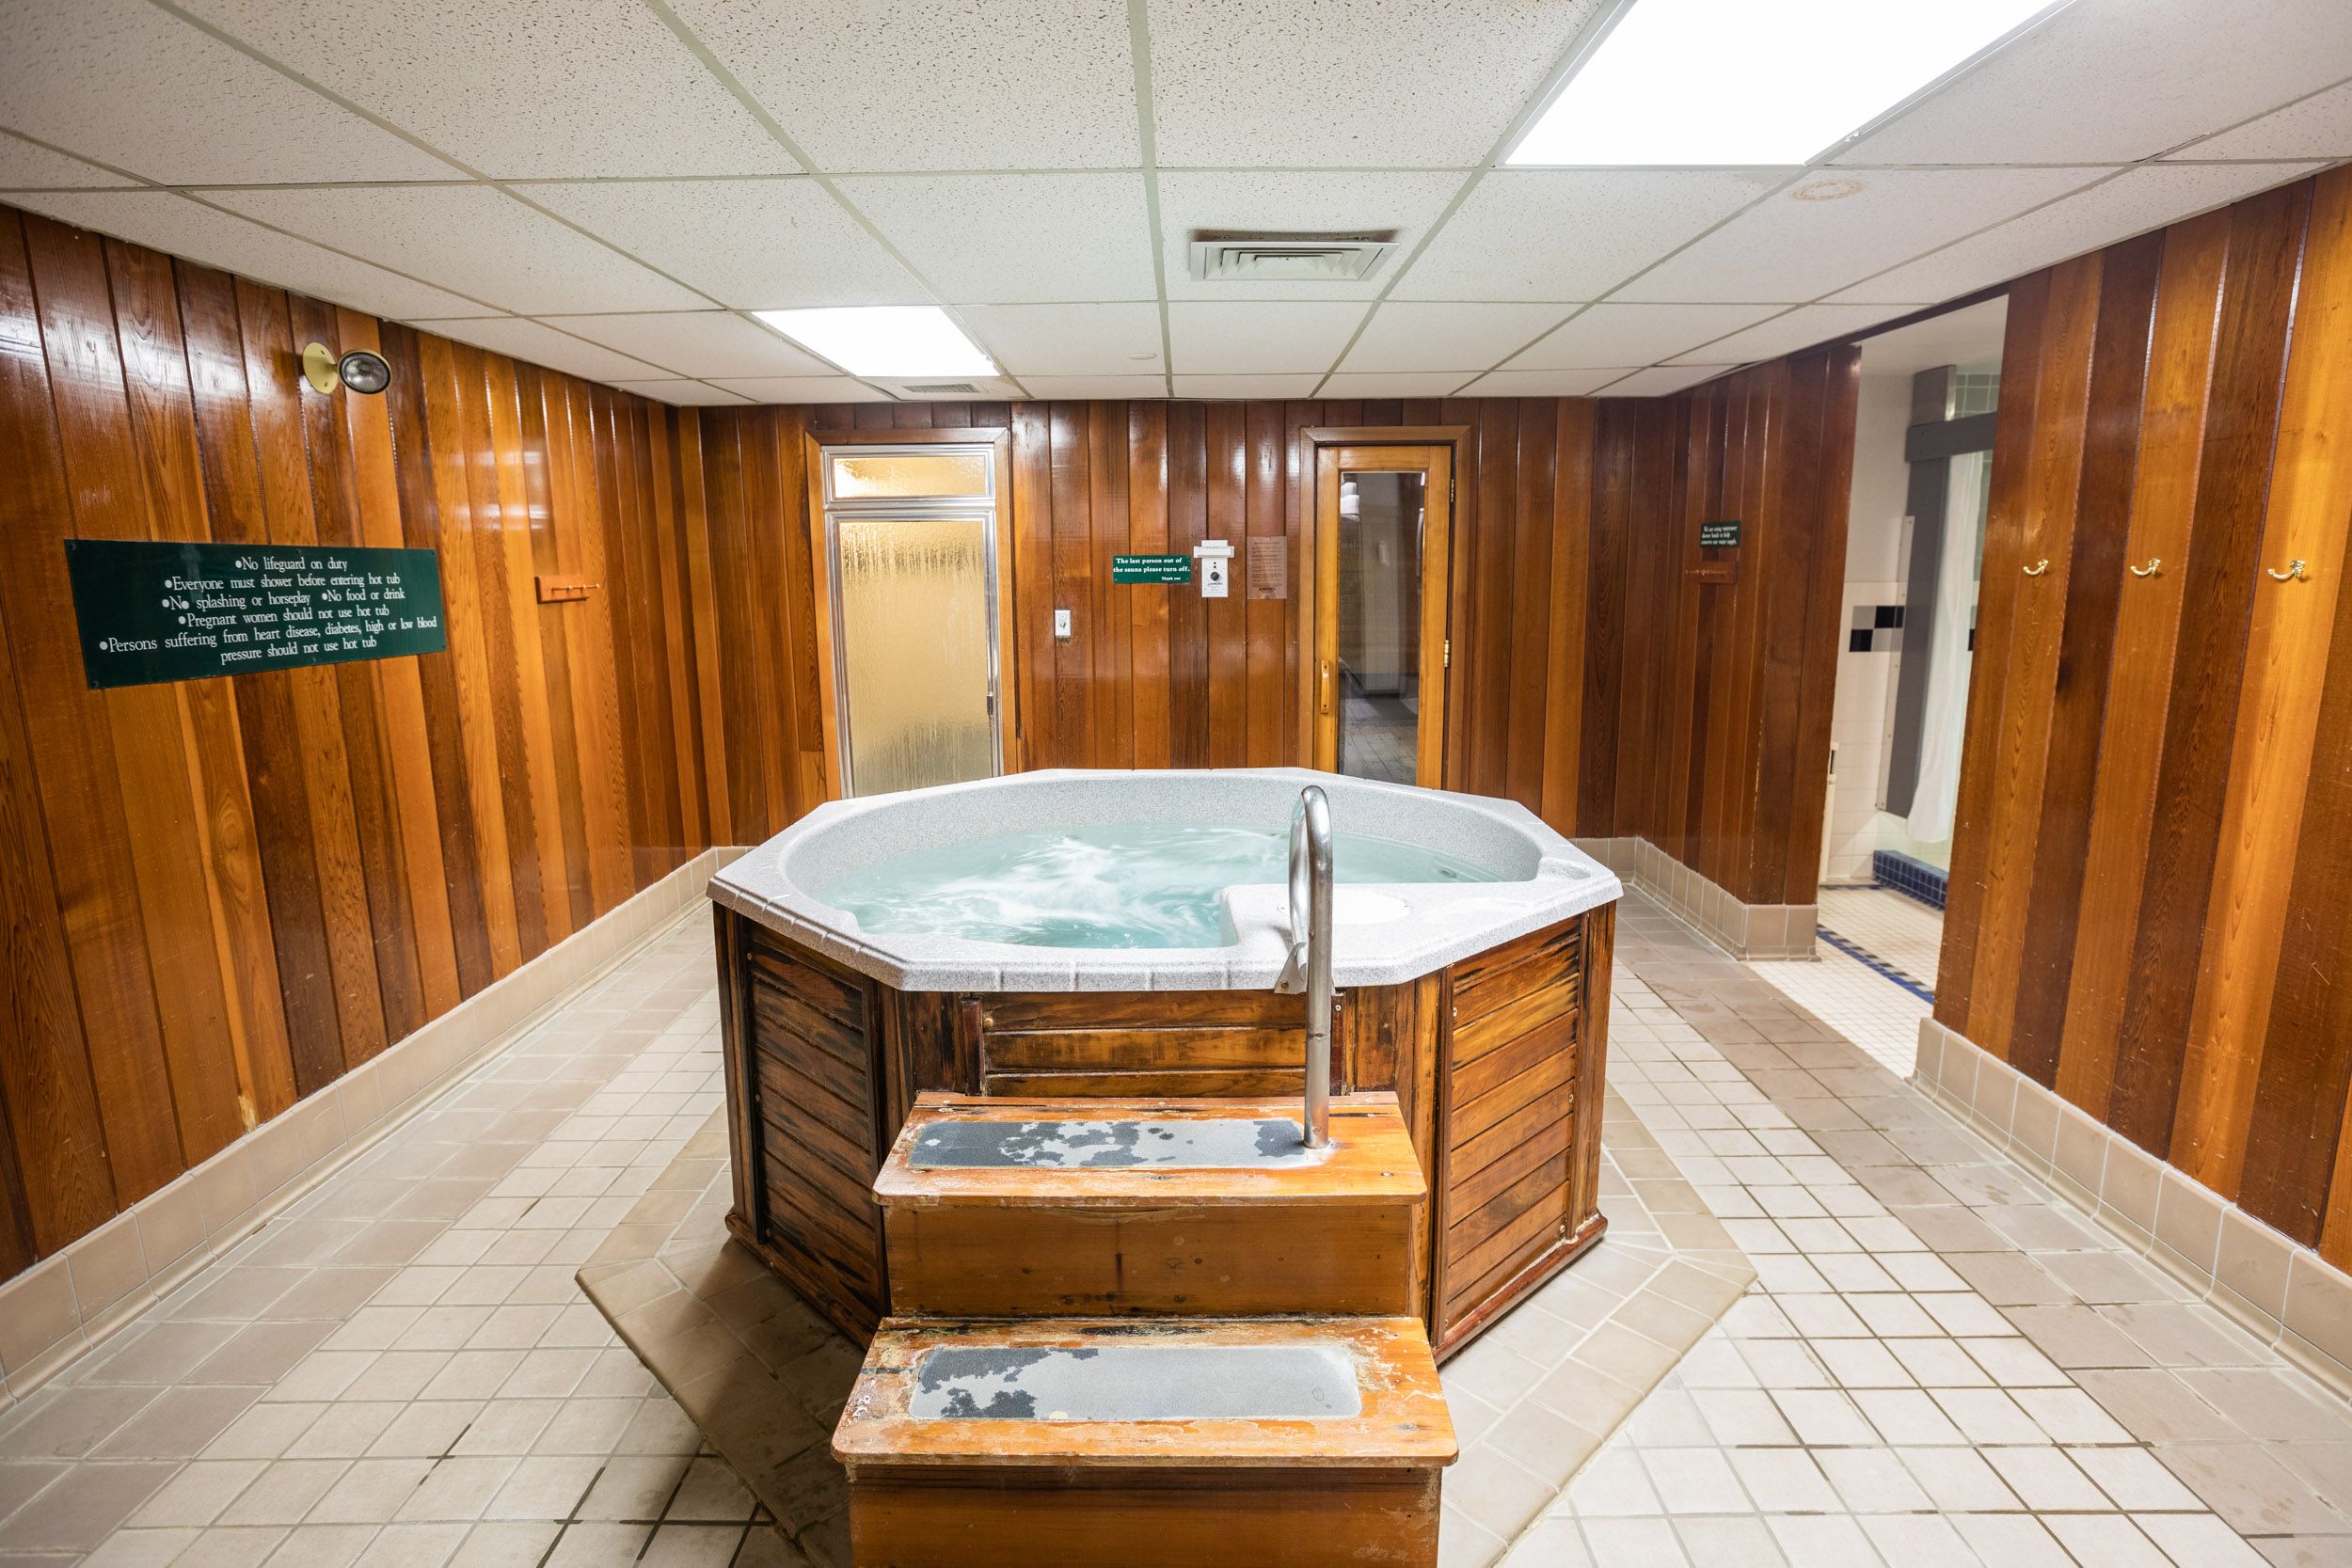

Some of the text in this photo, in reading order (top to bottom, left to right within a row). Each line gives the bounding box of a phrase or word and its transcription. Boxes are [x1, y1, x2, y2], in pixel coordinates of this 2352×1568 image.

[241, 557, 348, 573] No lifeguard on duty
[172, 572, 400, 593] Everyone must shower before entering hot tub
[169, 587, 406, 611] N splashing or horseplay No food or drink
[186, 604, 389, 628] Pregnant women should not use hot tub
[108, 616, 437, 653] Persons suffering from heart disease, diabetes, high or low blood
[220, 636, 376, 665] pressure should not use hot tub
